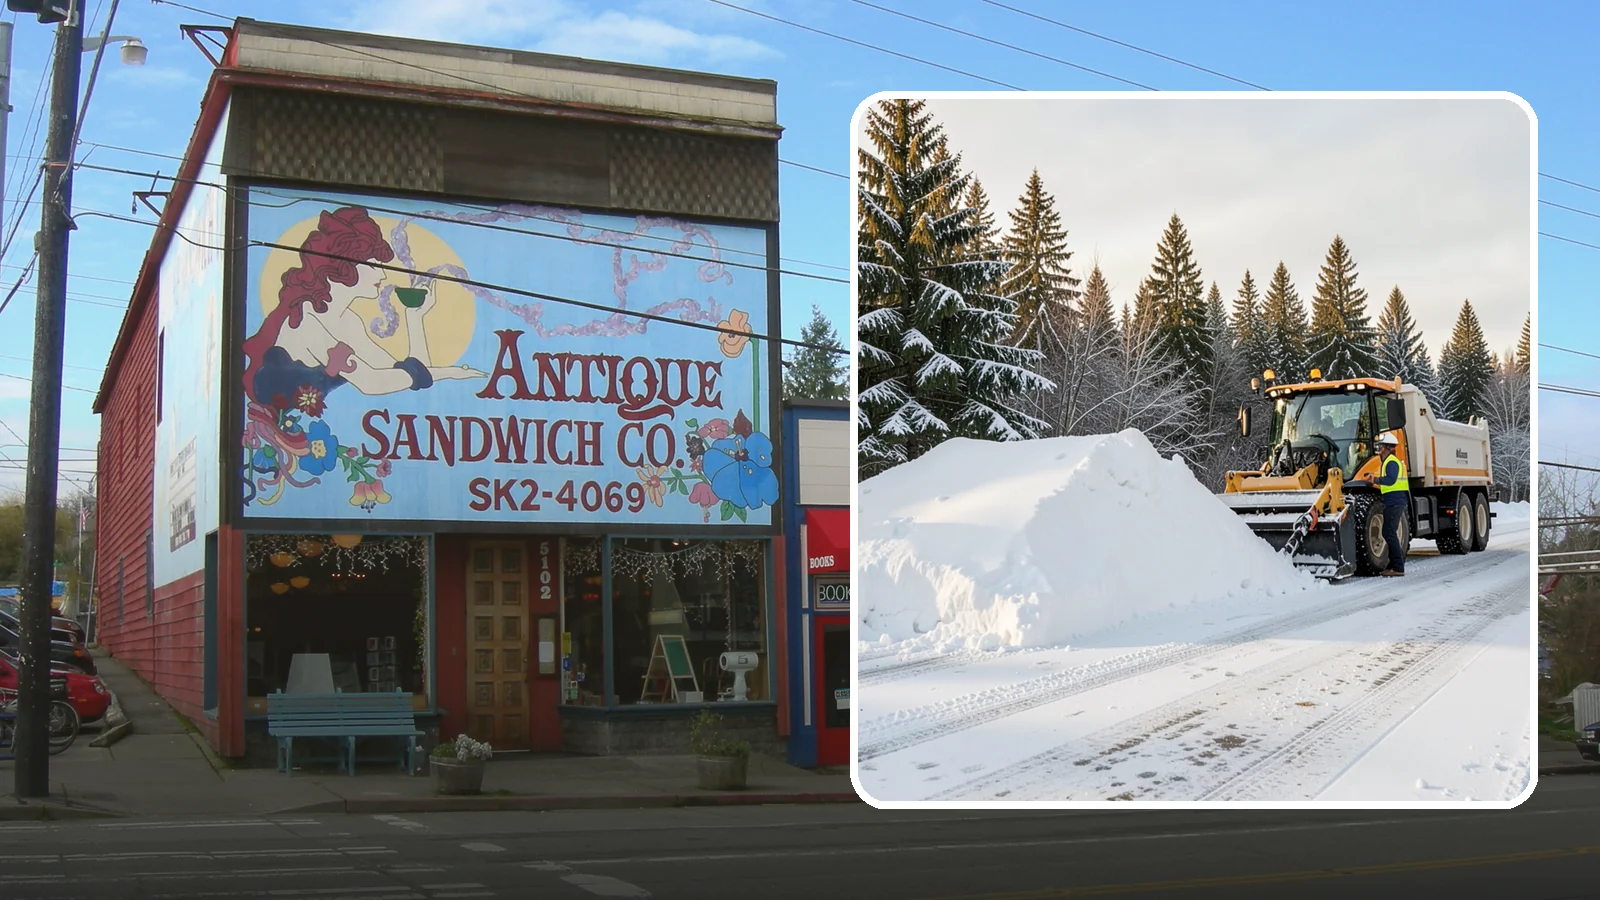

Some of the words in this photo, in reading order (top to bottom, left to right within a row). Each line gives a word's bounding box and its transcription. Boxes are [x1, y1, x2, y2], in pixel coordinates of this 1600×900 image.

[476, 329, 723, 420] ANTIQUE
[361, 408, 604, 466] SANDWICH
[617, 422, 684, 469] CO.
[468, 478, 645, 513] SK2-4069
[539, 541, 551, 600] 5102
[809, 555, 834, 568] BOOKS
